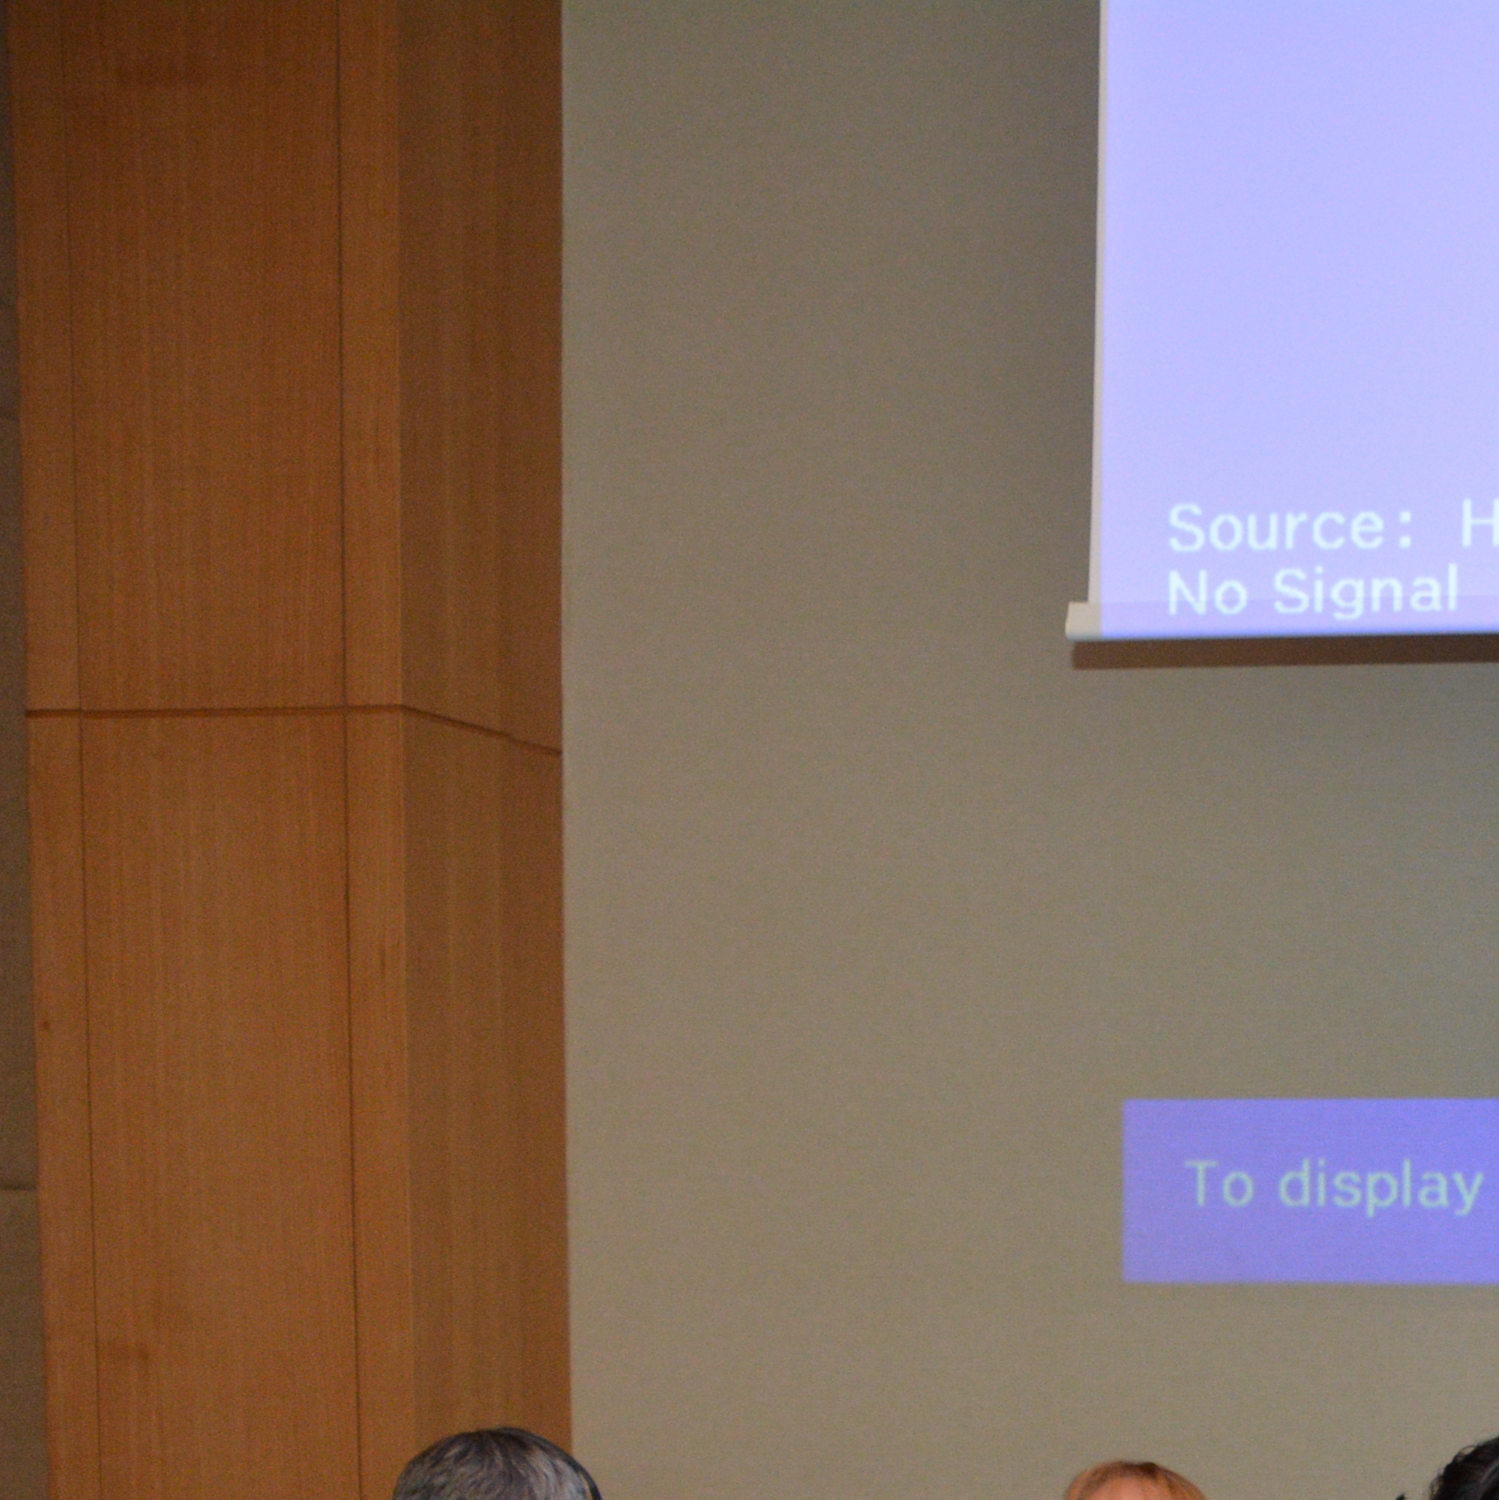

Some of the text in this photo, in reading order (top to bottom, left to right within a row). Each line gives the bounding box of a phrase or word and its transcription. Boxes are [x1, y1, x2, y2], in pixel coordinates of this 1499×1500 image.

[1168, 502, 1412, 553] Source:
[1167, 562, 1458, 620] No Signal
[1184, 1158, 1255, 1208] To
[1278, 1157, 1484, 1218] display
